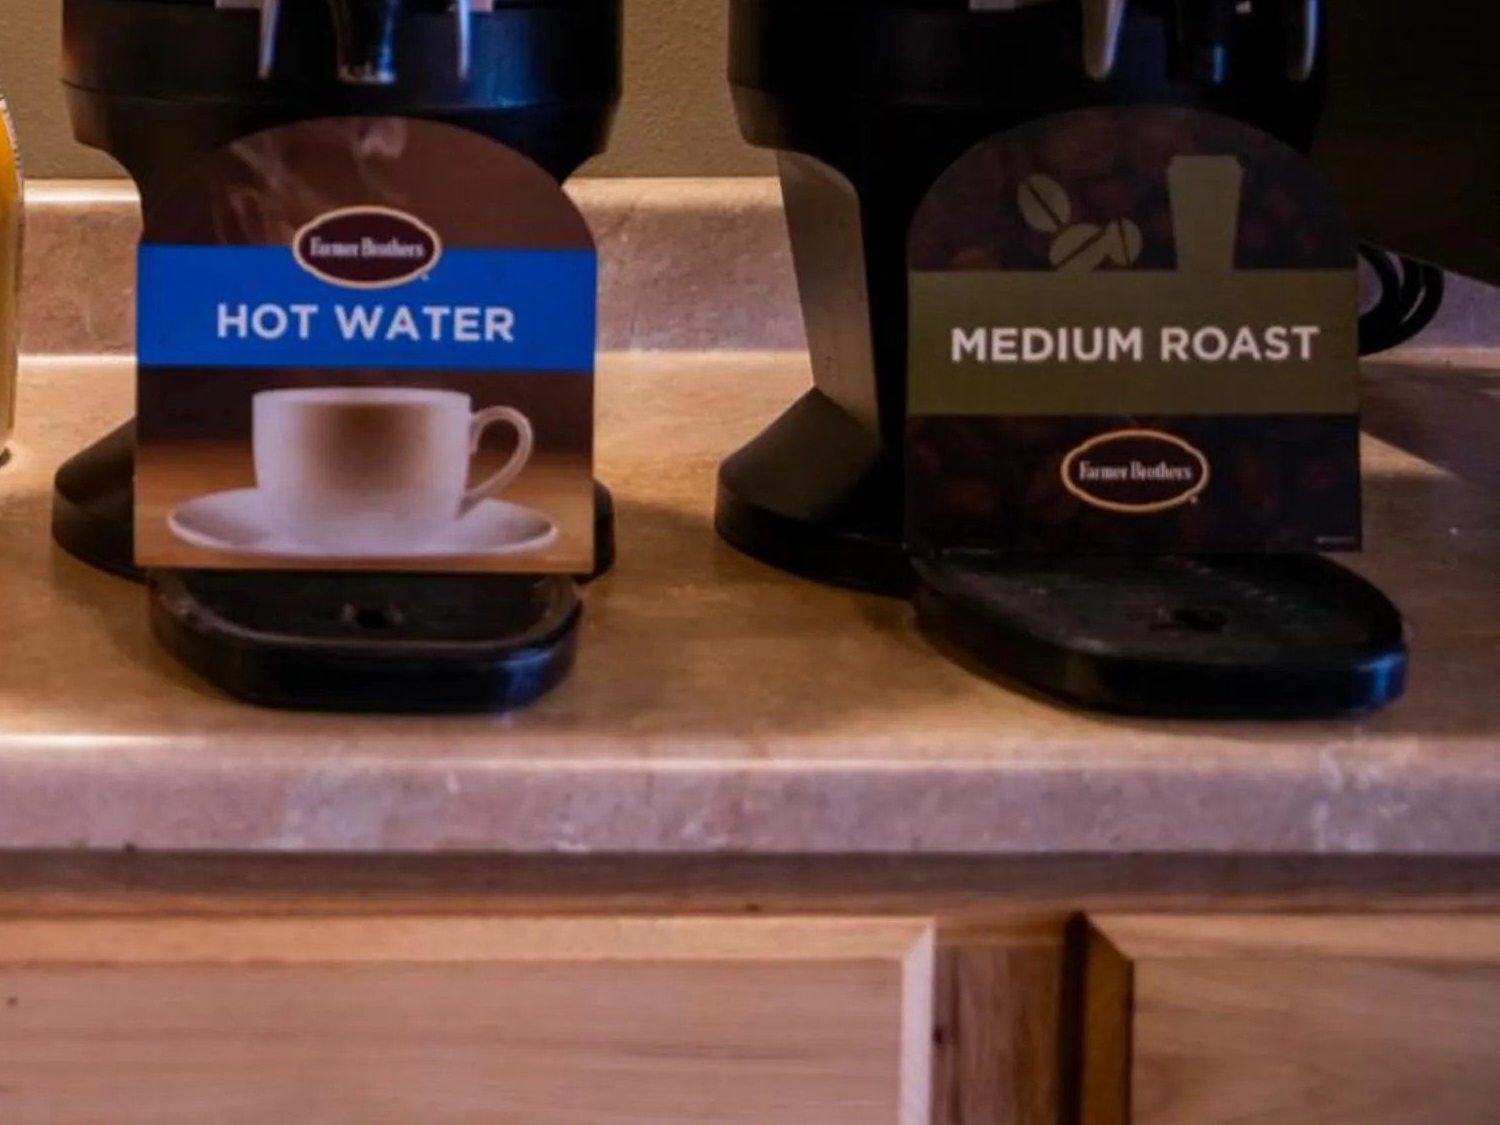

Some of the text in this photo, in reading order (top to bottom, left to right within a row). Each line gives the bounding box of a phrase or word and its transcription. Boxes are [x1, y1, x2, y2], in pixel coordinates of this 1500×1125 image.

[361, 236, 425, 259] Brothers
[216, 303, 516, 343] HOT WATER
[950, 326, 1321, 363] MEDIUM ROAST
[1079, 459, 1192, 481] Farmer Brothers
